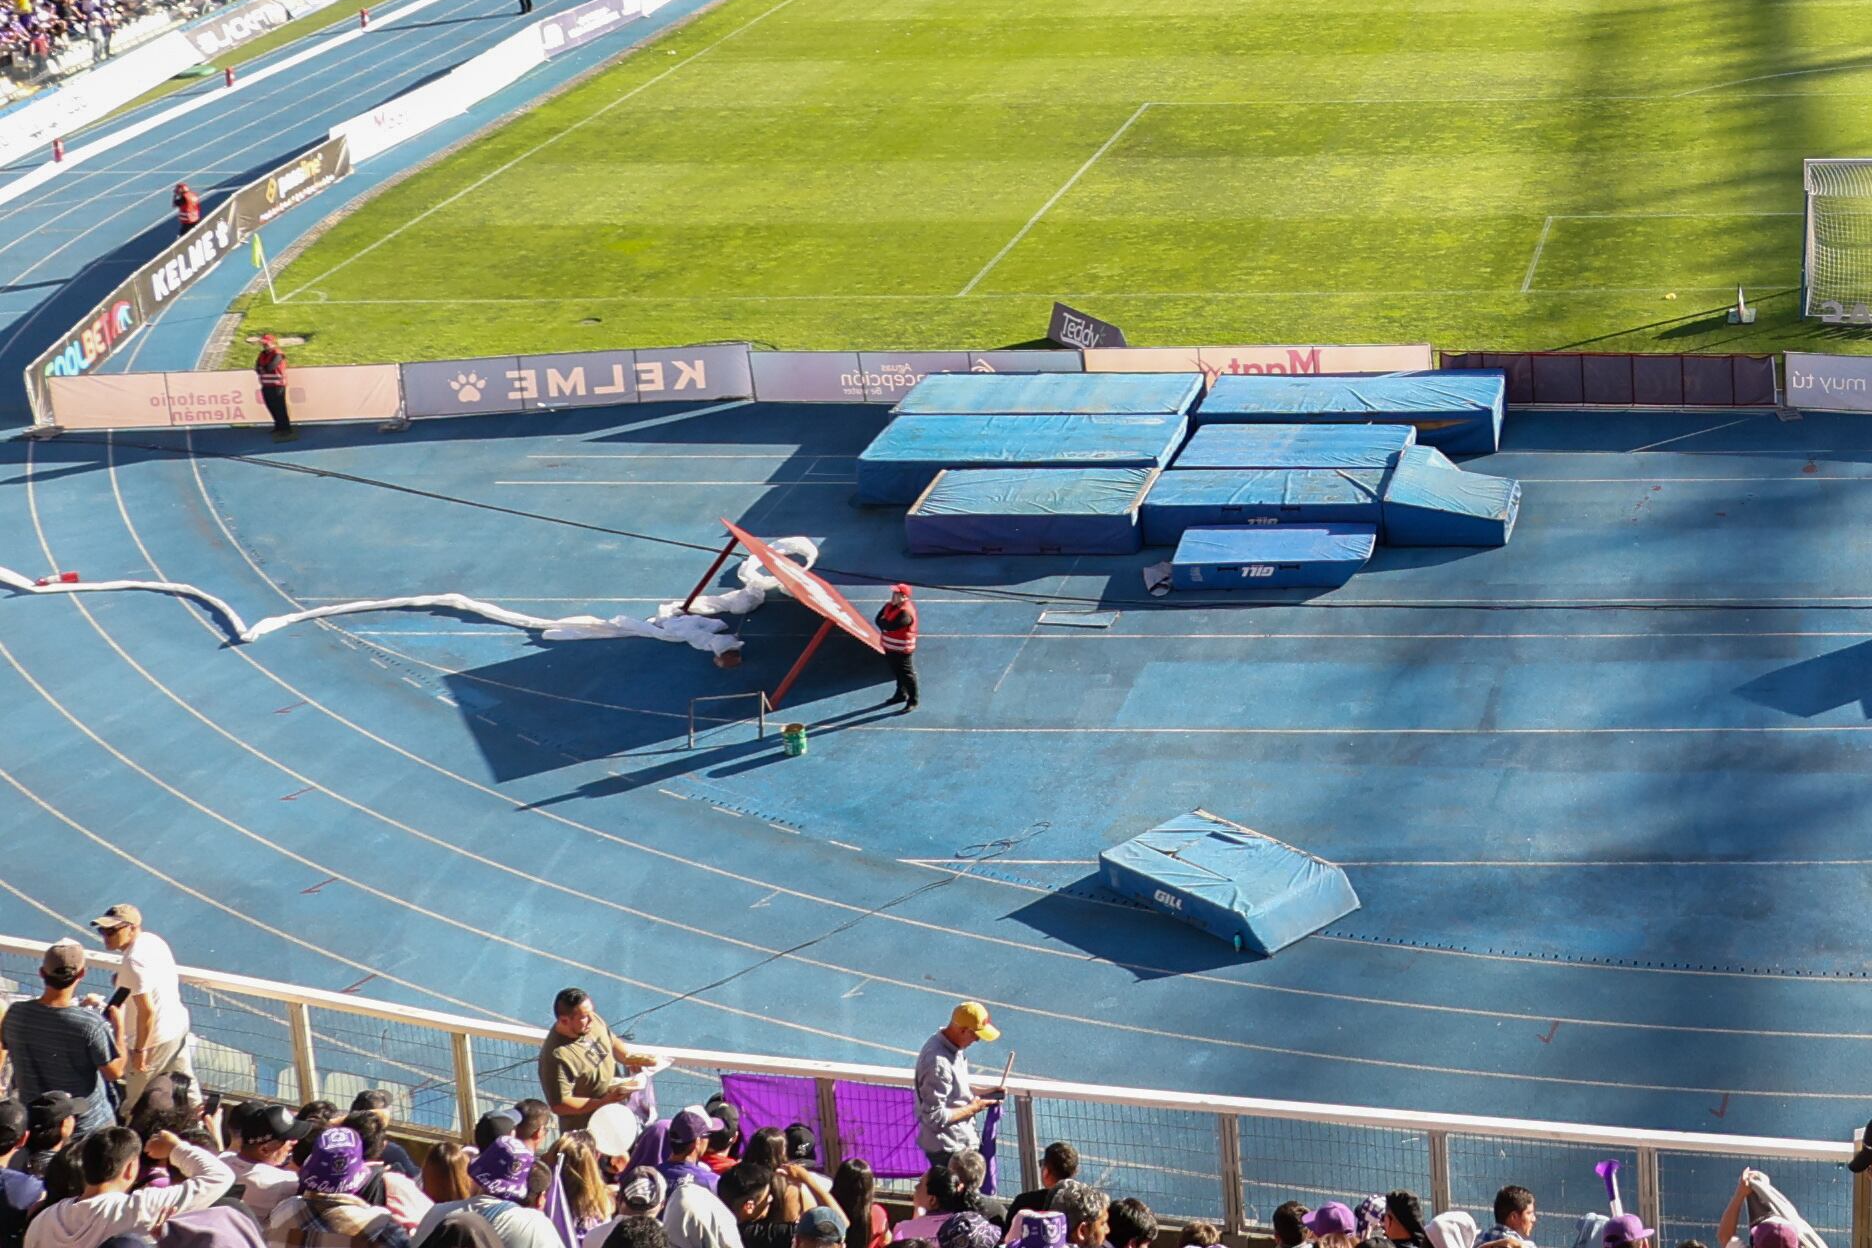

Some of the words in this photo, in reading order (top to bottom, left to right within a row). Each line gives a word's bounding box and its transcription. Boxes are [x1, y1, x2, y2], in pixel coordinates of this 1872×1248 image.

[151, 236, 217, 301] KELME
[1061, 312, 1100, 348] Teddy
[1153, 888, 1183, 911] GILL
